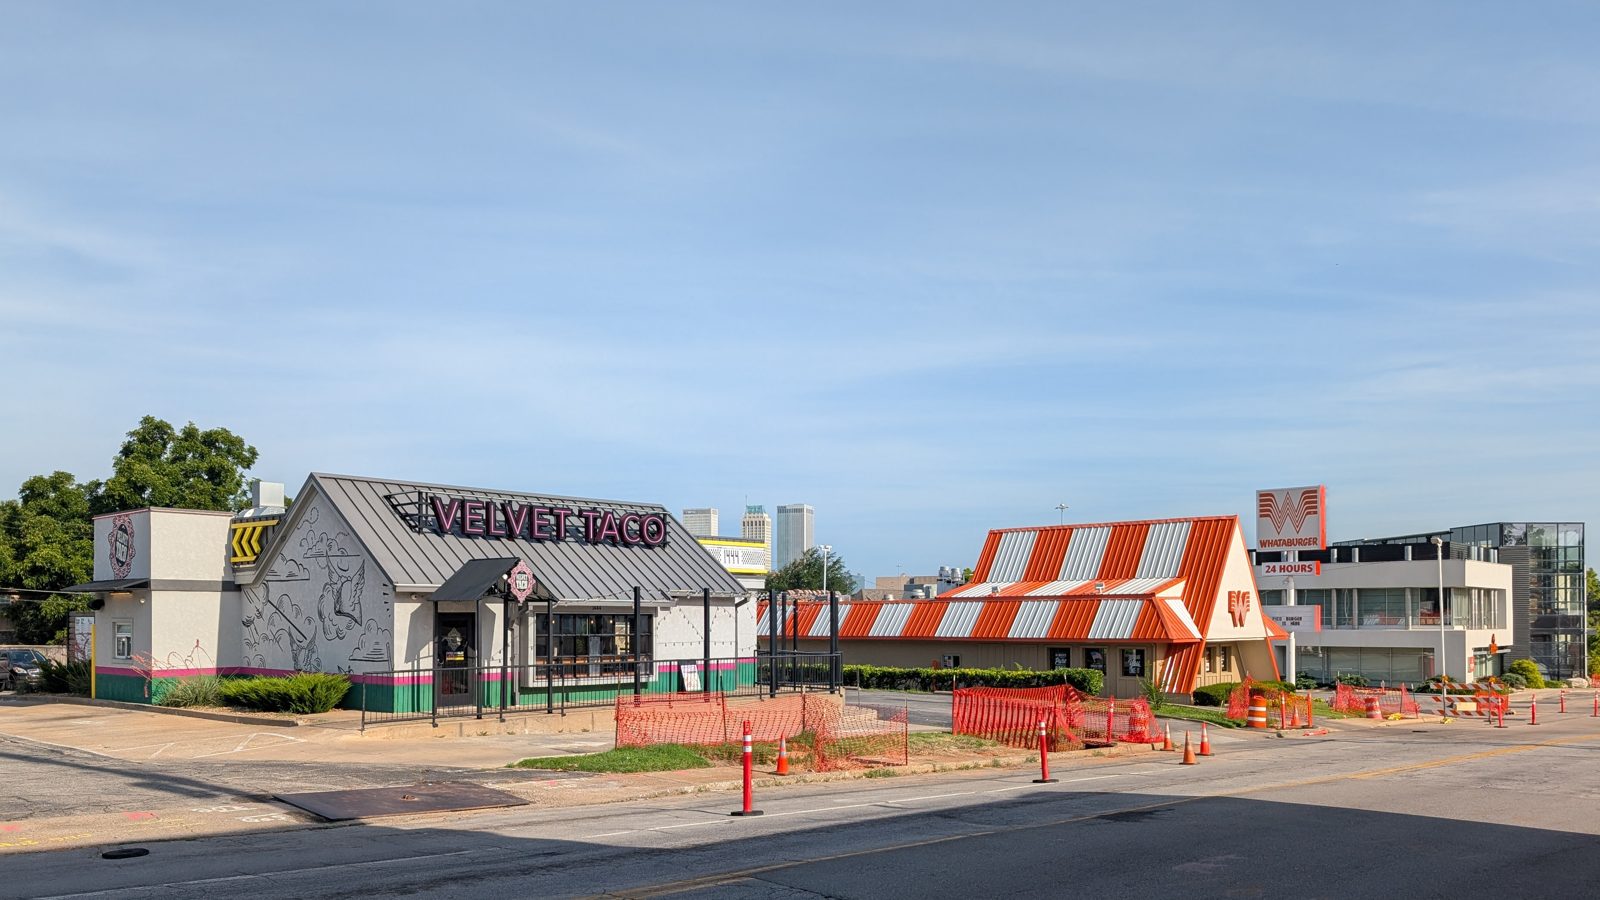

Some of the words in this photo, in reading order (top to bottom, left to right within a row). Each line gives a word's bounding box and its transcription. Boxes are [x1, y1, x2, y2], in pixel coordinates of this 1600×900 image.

[429, 496, 572, 541] VELVET
[577, 508, 666, 546] TACO
[1260, 537, 1318, 548] WHATABURGER
[1265, 565, 1276, 574] 24
[1279, 564, 1313, 574] HOURS
